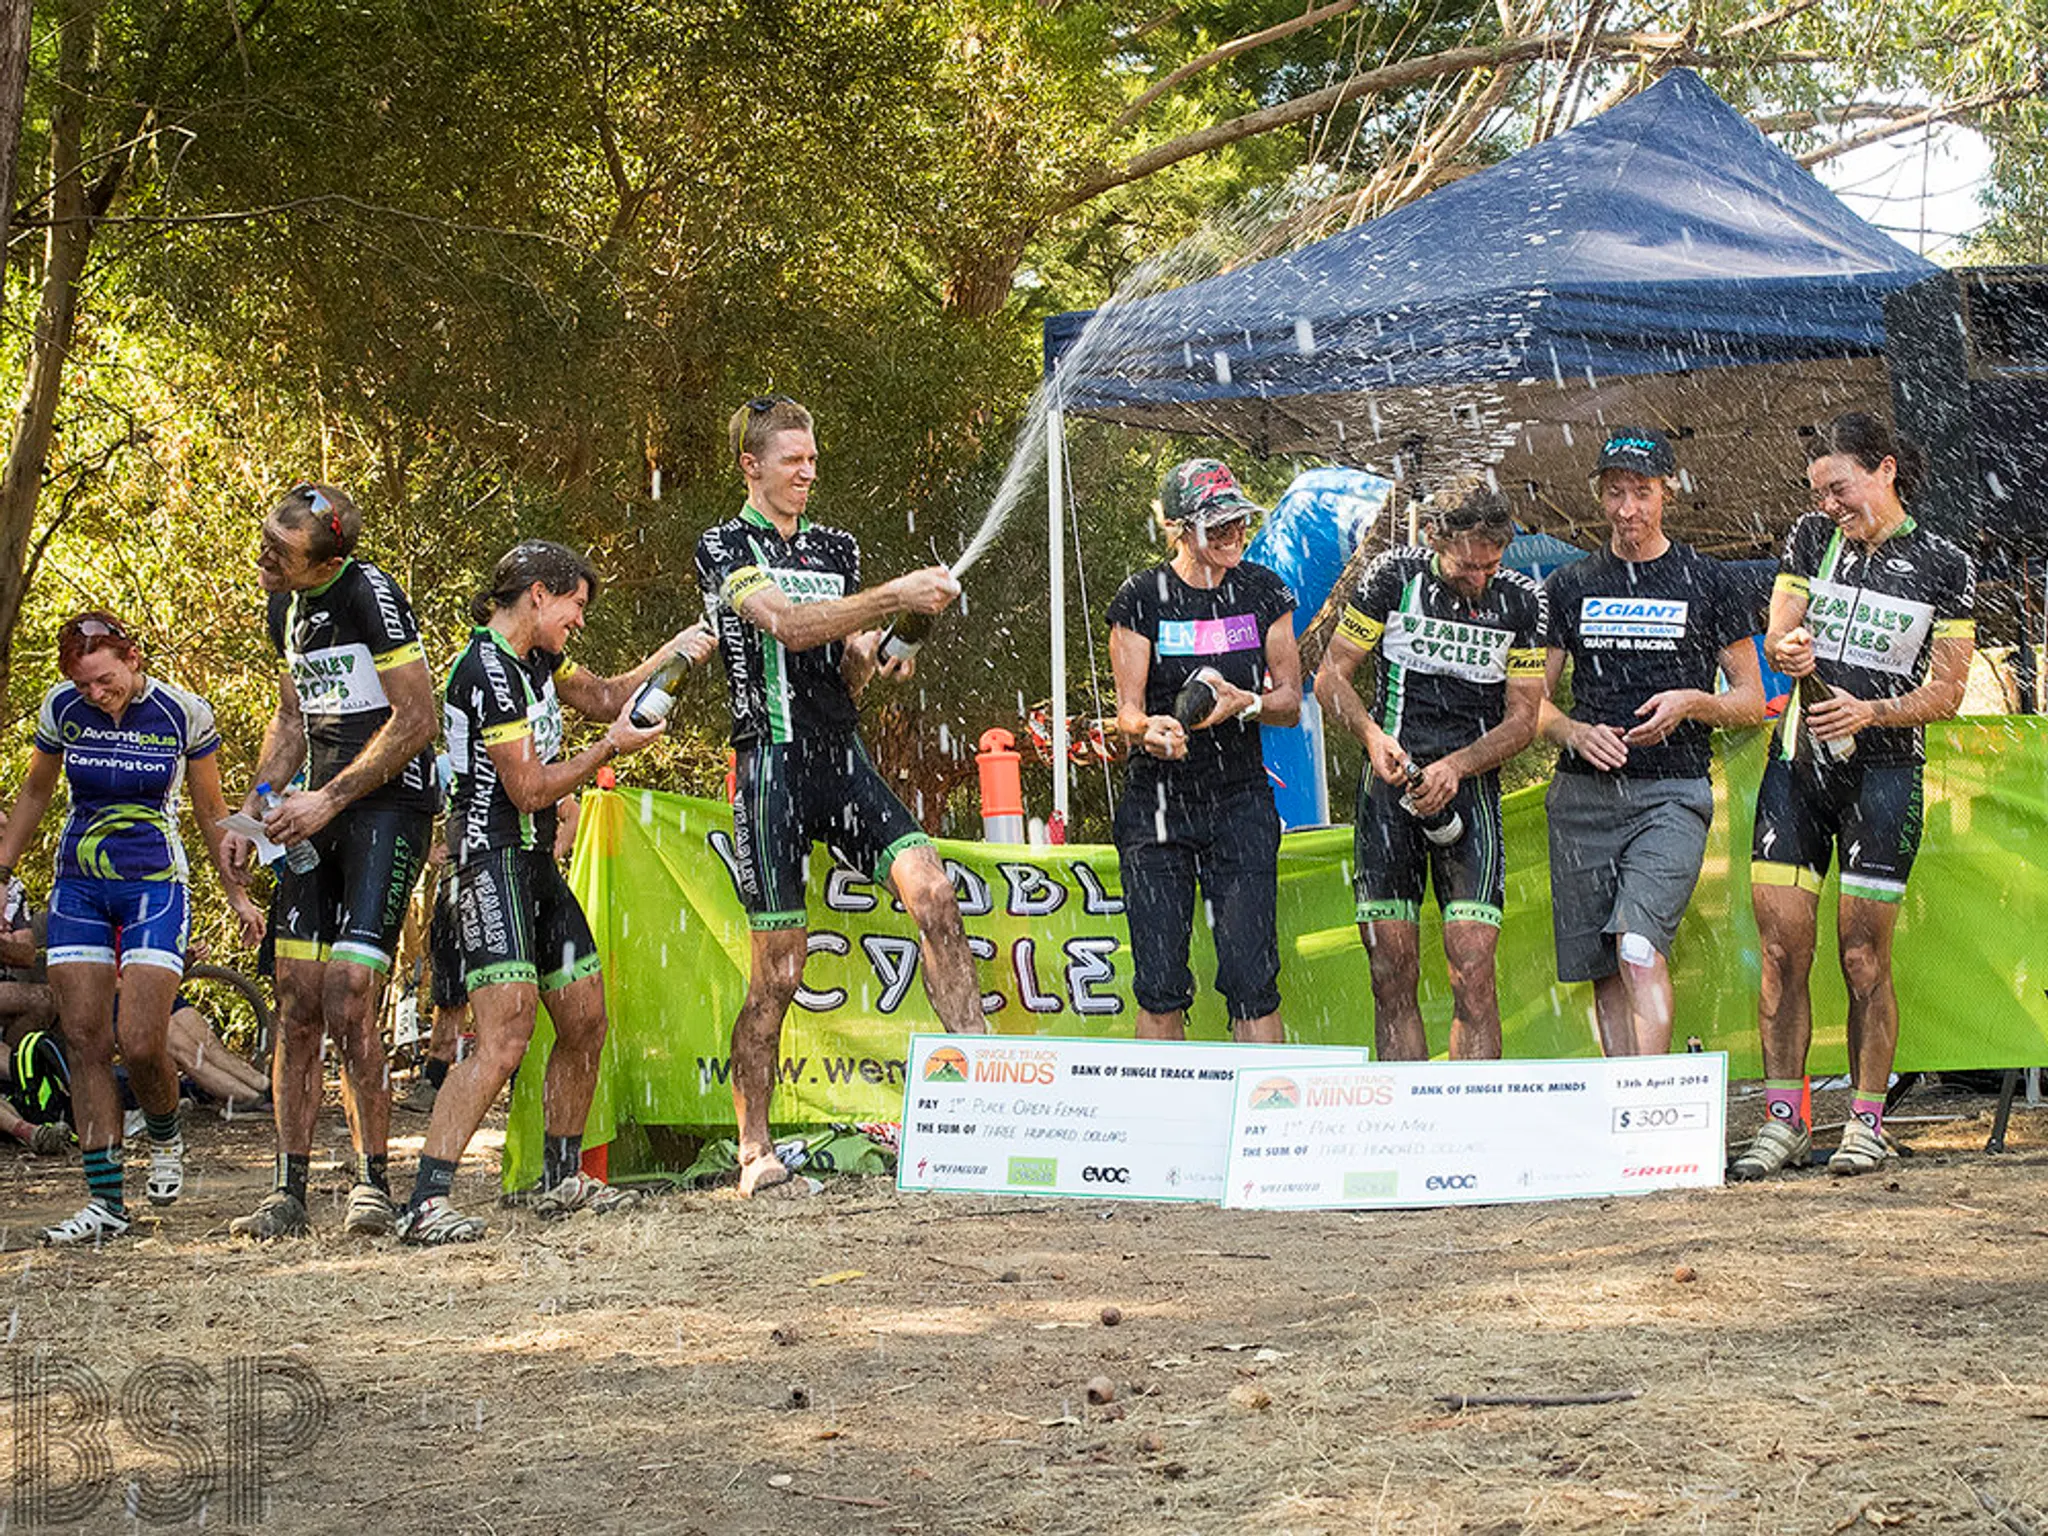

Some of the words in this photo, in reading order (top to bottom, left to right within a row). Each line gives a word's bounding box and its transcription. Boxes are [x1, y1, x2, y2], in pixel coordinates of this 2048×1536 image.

[1605, 604, 1682, 617] GIANT
[1402, 616, 1507, 648] WEMBLEY
[1411, 638, 1491, 666] CYCLES
[68, 753, 166, 772] Cannington
[975, 1061, 1055, 1084] MINDS
[1071, 1065, 1101, 1076] BANK
[1104, 1066, 1118, 1077] OF
[1121, 1067, 1157, 1079] SINGLE
[1161, 1069, 1195, 1080] TRACK
[1198, 1070, 1234, 1081] MINDS
[1411, 1085, 1443, 1096] BANK
[1446, 1084, 1463, 1095] OF
[1465, 1083, 1503, 1095] SINGLE
[1507, 1083, 1544, 1093] TRACK
[1548, 1082, 1587, 1092] MINDS
[1616, 1079, 1642, 1089] 13th
[1646, 1077, 1675, 1089] April
[918, 1099, 939, 1109] PAY
[1305, 1085, 1394, 1107] MINDS
[1620, 1110, 1630, 1128] $
[916, 1122, 934, 1133] THE
[937, 1123, 960, 1134] SUM
[963, 1124, 976, 1134] OF
[1245, 1126, 1267, 1135] PAY
[1243, 1147, 1261, 1157] THE
[1266, 1146, 1290, 1156] SUM
[1294, 1145, 1309, 1155] OF
[1082, 1165, 1131, 1183] evoc
[1426, 1174, 1477, 1191] evoc
